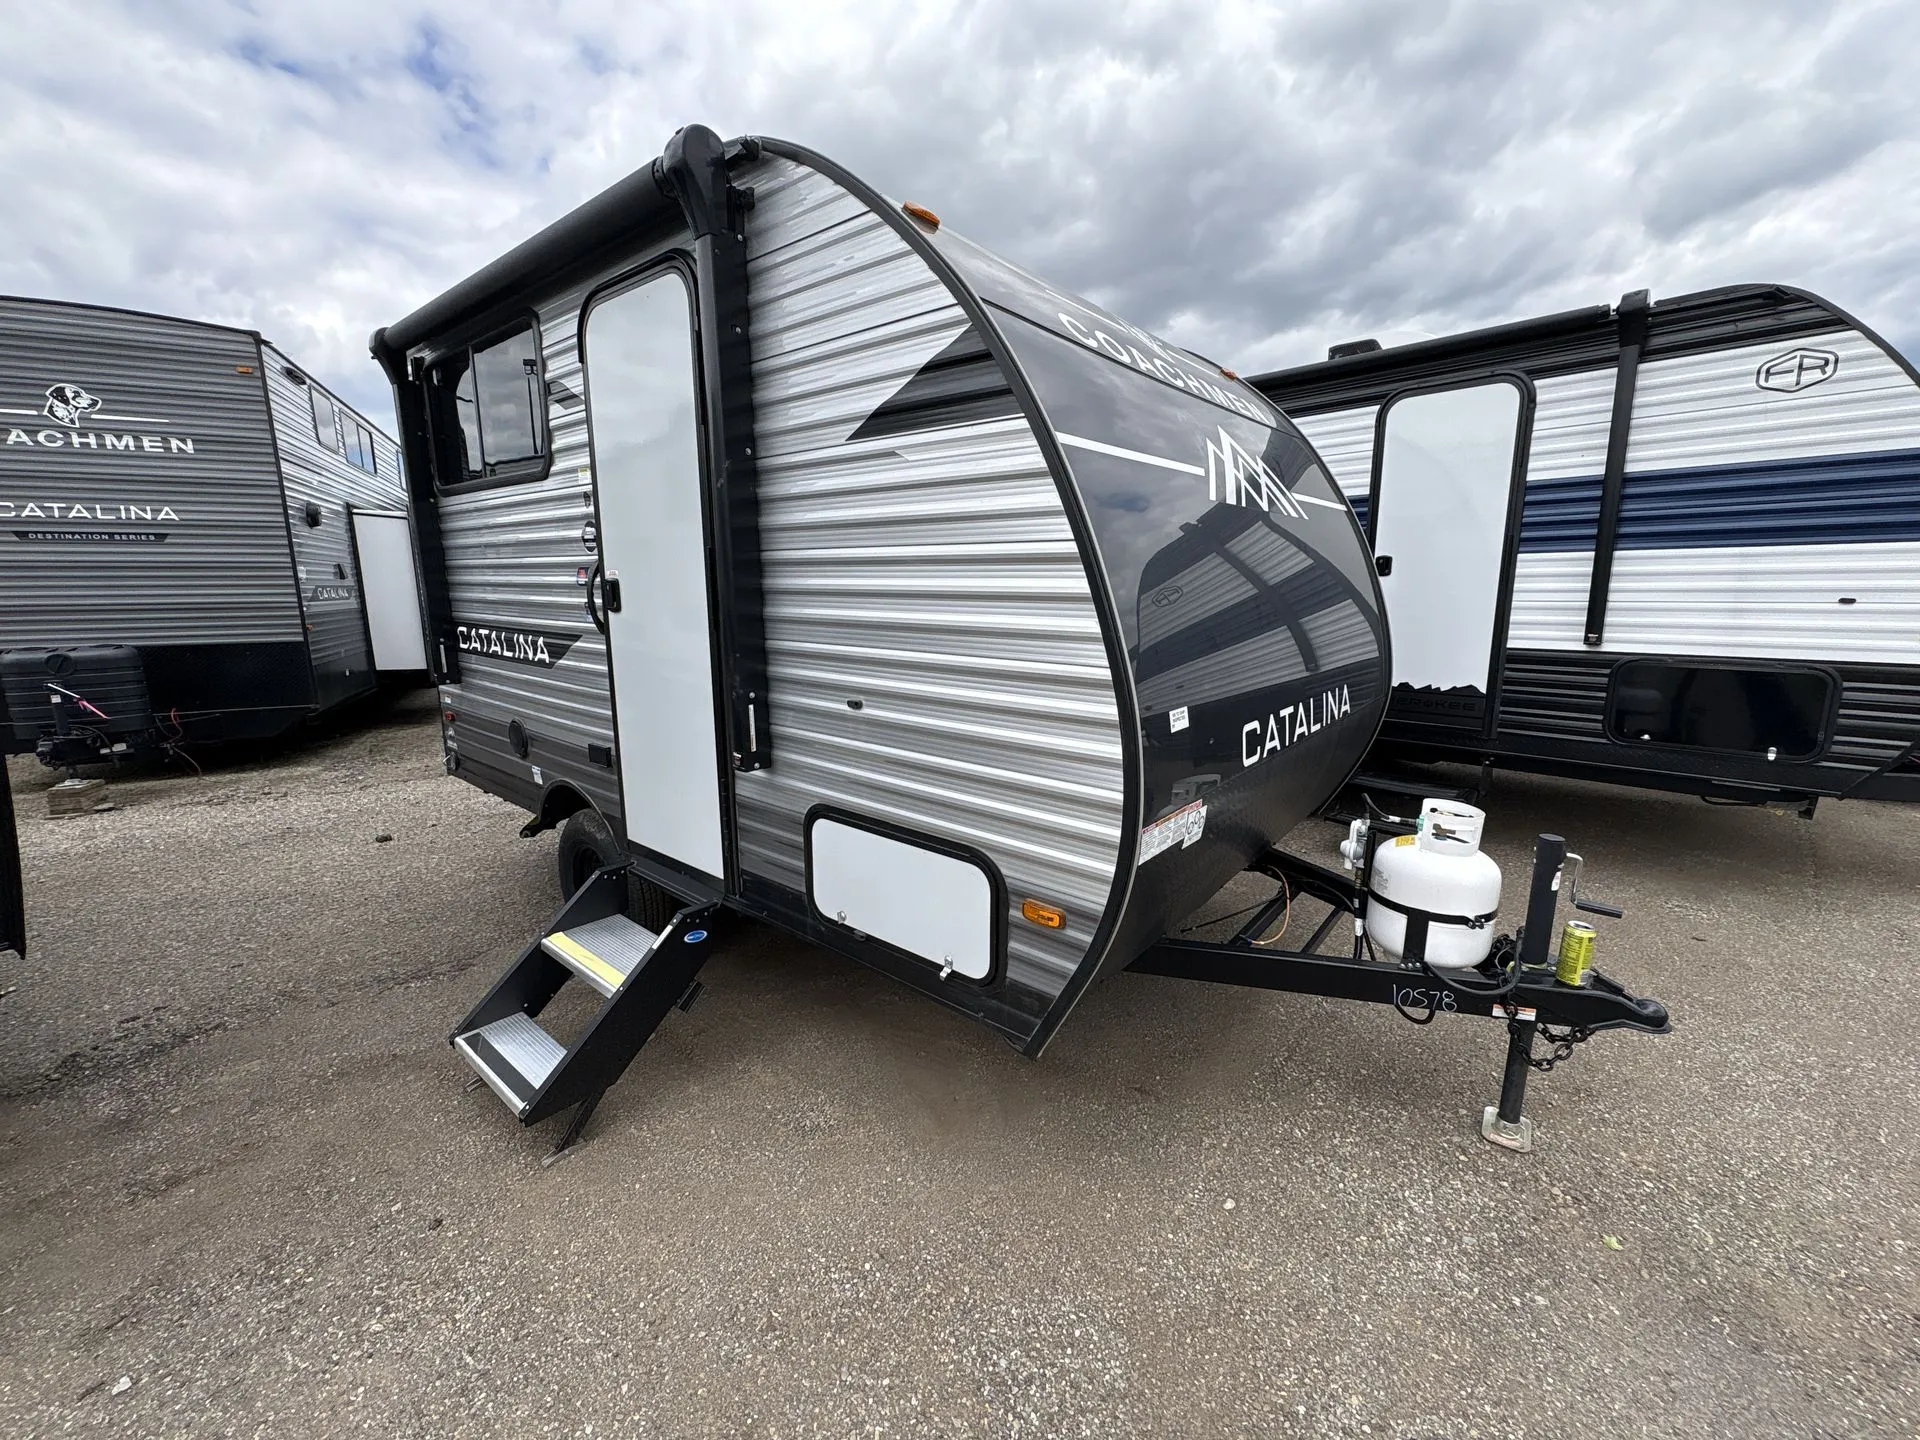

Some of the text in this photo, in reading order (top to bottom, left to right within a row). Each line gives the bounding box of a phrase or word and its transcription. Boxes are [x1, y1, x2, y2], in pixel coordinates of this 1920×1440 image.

[1057, 312, 1271, 425] COACHMEN
[28, 532, 156, 542] DESTINATION SERIES
[457, 626, 550, 664] CATALINA
[1242, 683, 1351, 768] CATALINA
[1393, 983, 1457, 1012] 10578
